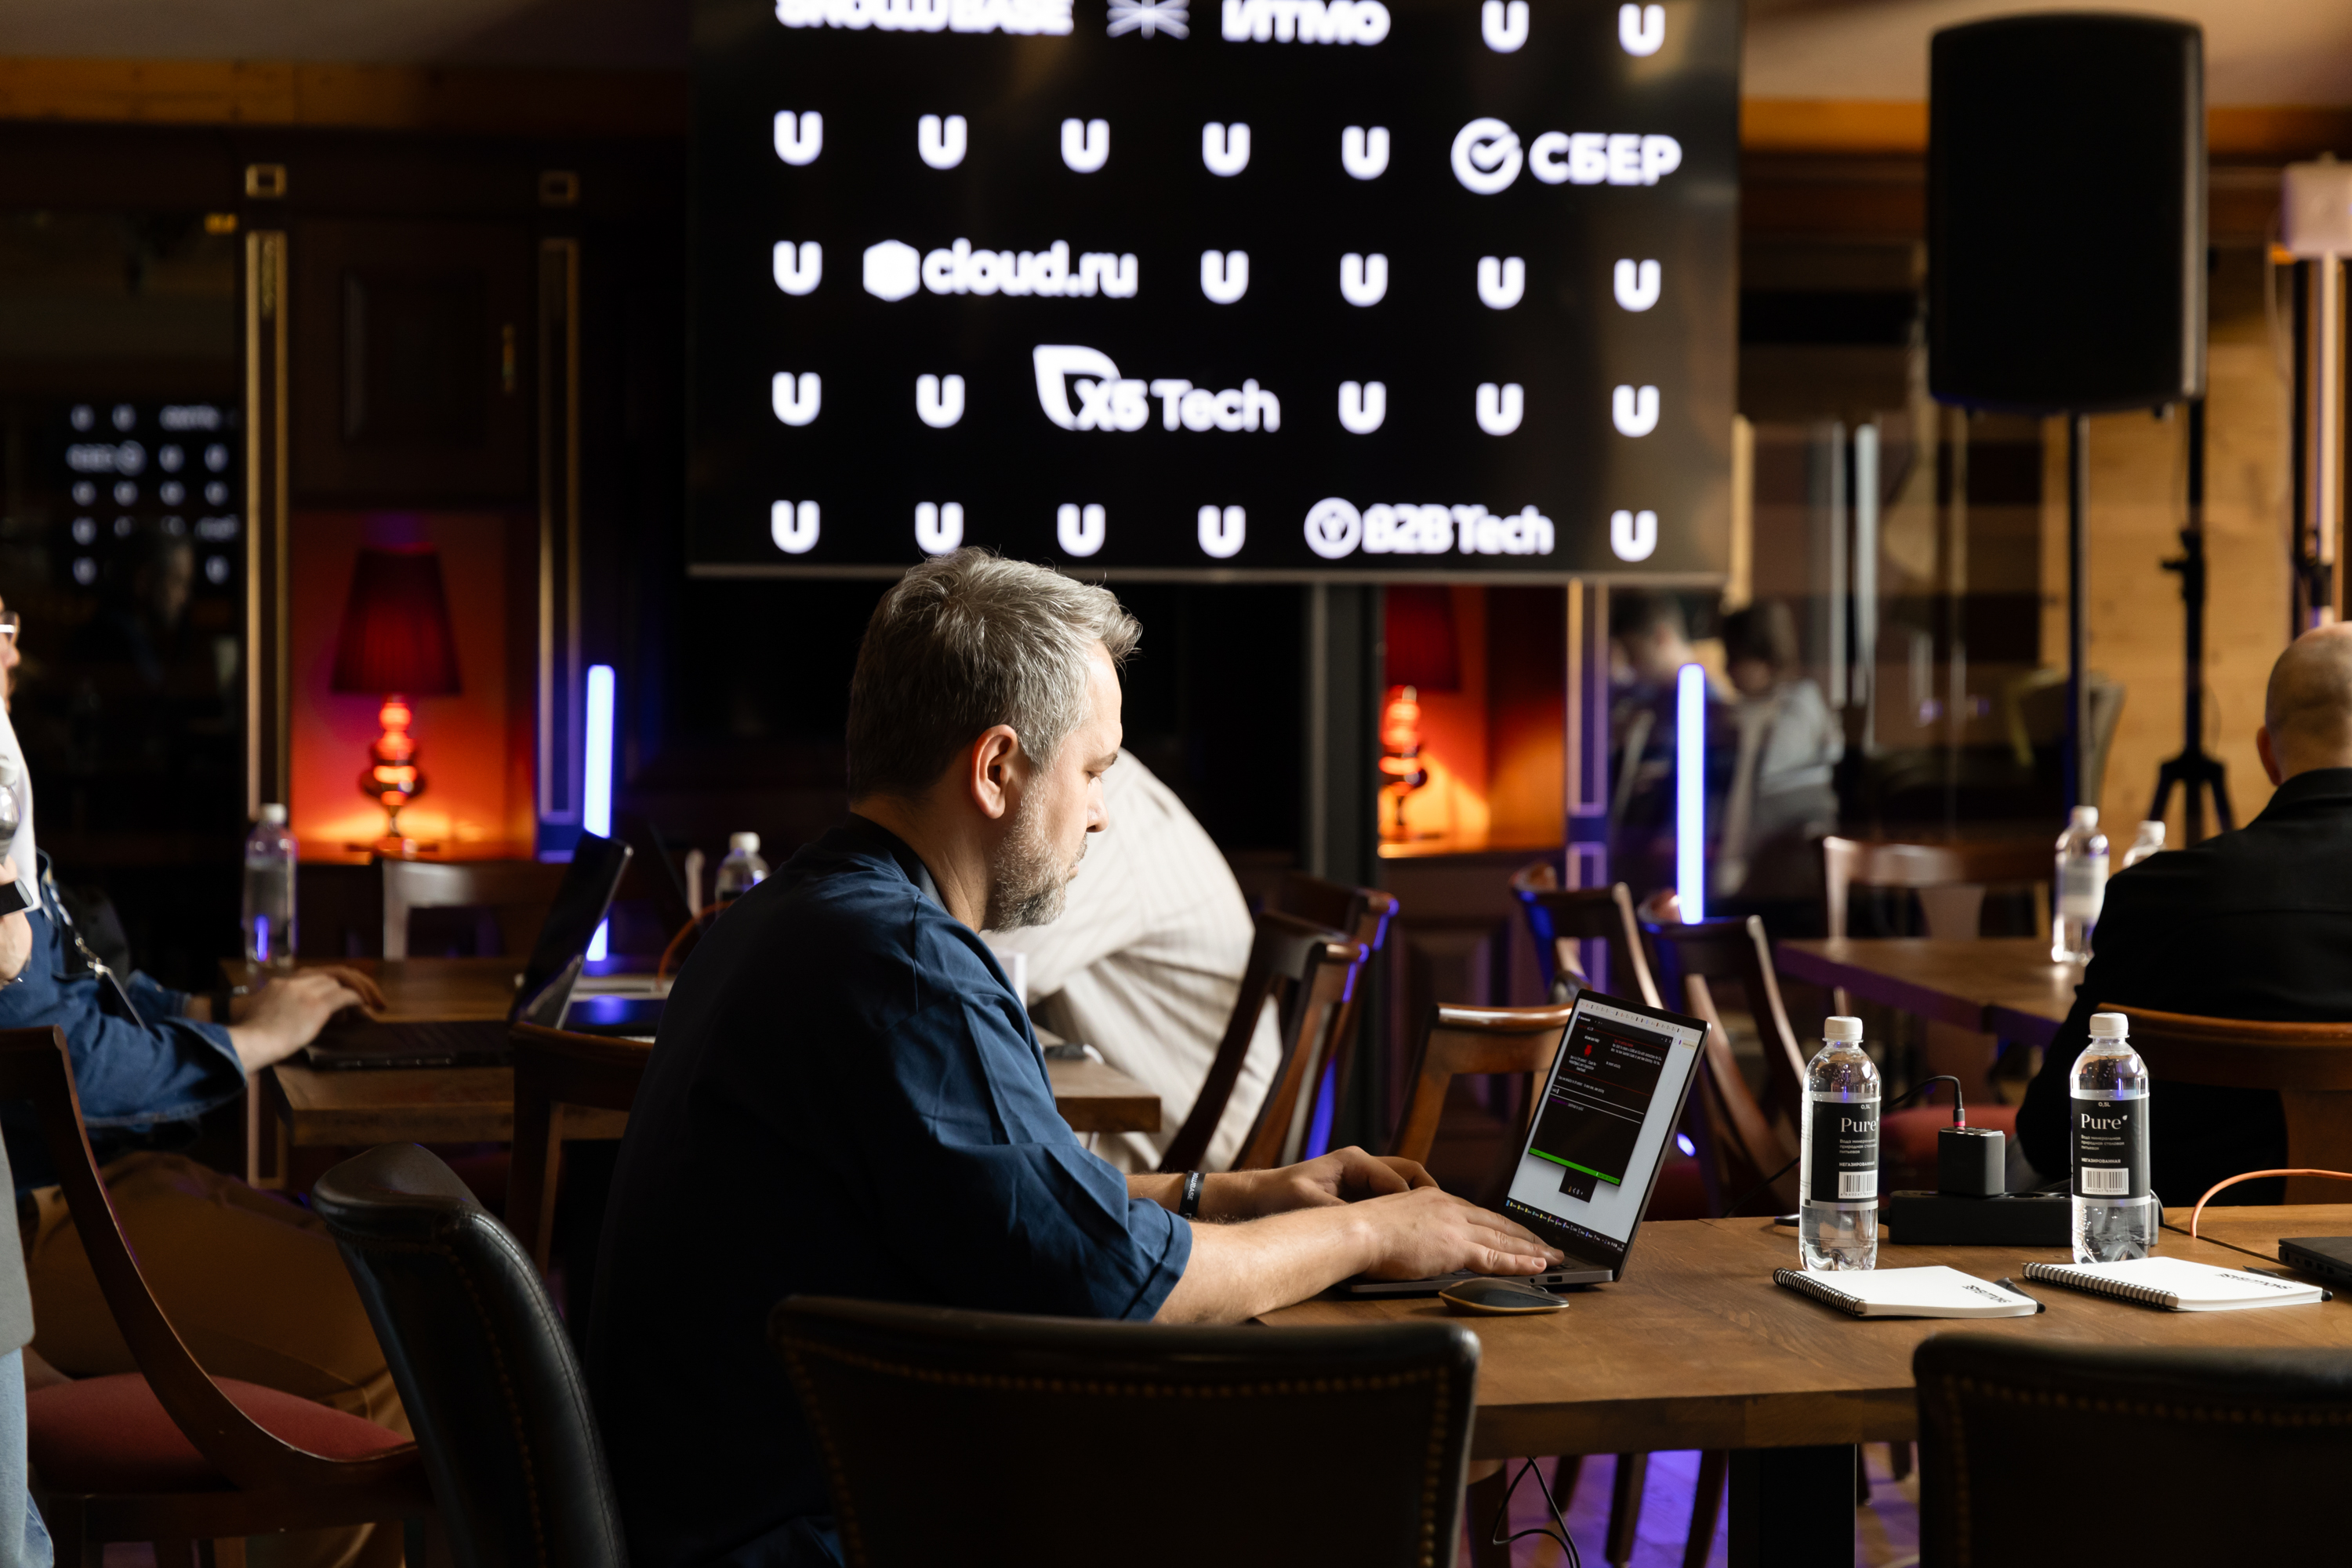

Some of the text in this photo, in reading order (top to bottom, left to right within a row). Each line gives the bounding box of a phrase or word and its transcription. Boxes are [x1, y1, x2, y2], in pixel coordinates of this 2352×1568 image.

[1221, 0, 1390, 45] ИТМО
[1482, 0, 1529, 53] U
[1618, 4, 1665, 56] U
[775, 111, 822, 165] U
[918, 115, 967, 169] U
[1062, 119, 1110, 172] U
[1202, 123, 1250, 176] U
[1342, 127, 1390, 180] U
[1530, 132, 1682, 185] СБЕР
[773, 241, 822, 296] U
[922, 238, 1138, 297] cloud.ru
[1201, 251, 1249, 304] U
[1341, 254, 1388, 307] U
[1478, 257, 1526, 310] U
[1613, 260, 1661, 312] U
[772, 372, 822, 426] U
[916, 375, 965, 428] U
[1150, 379, 1279, 431] Tech
[1339, 382, 1386, 434] U
[1476, 383, 1524, 436] U
[1613, 385, 1661, 437] U
[771, 501, 820, 554] U
[915, 503, 964, 555] U
[1058, 504, 1105, 557] U
[1198, 506, 1246, 558] U
[1611, 510, 1658, 562] U
[1841, 1117, 1877, 1133] Pure
[2081, 1113, 2122, 1130] Pure
